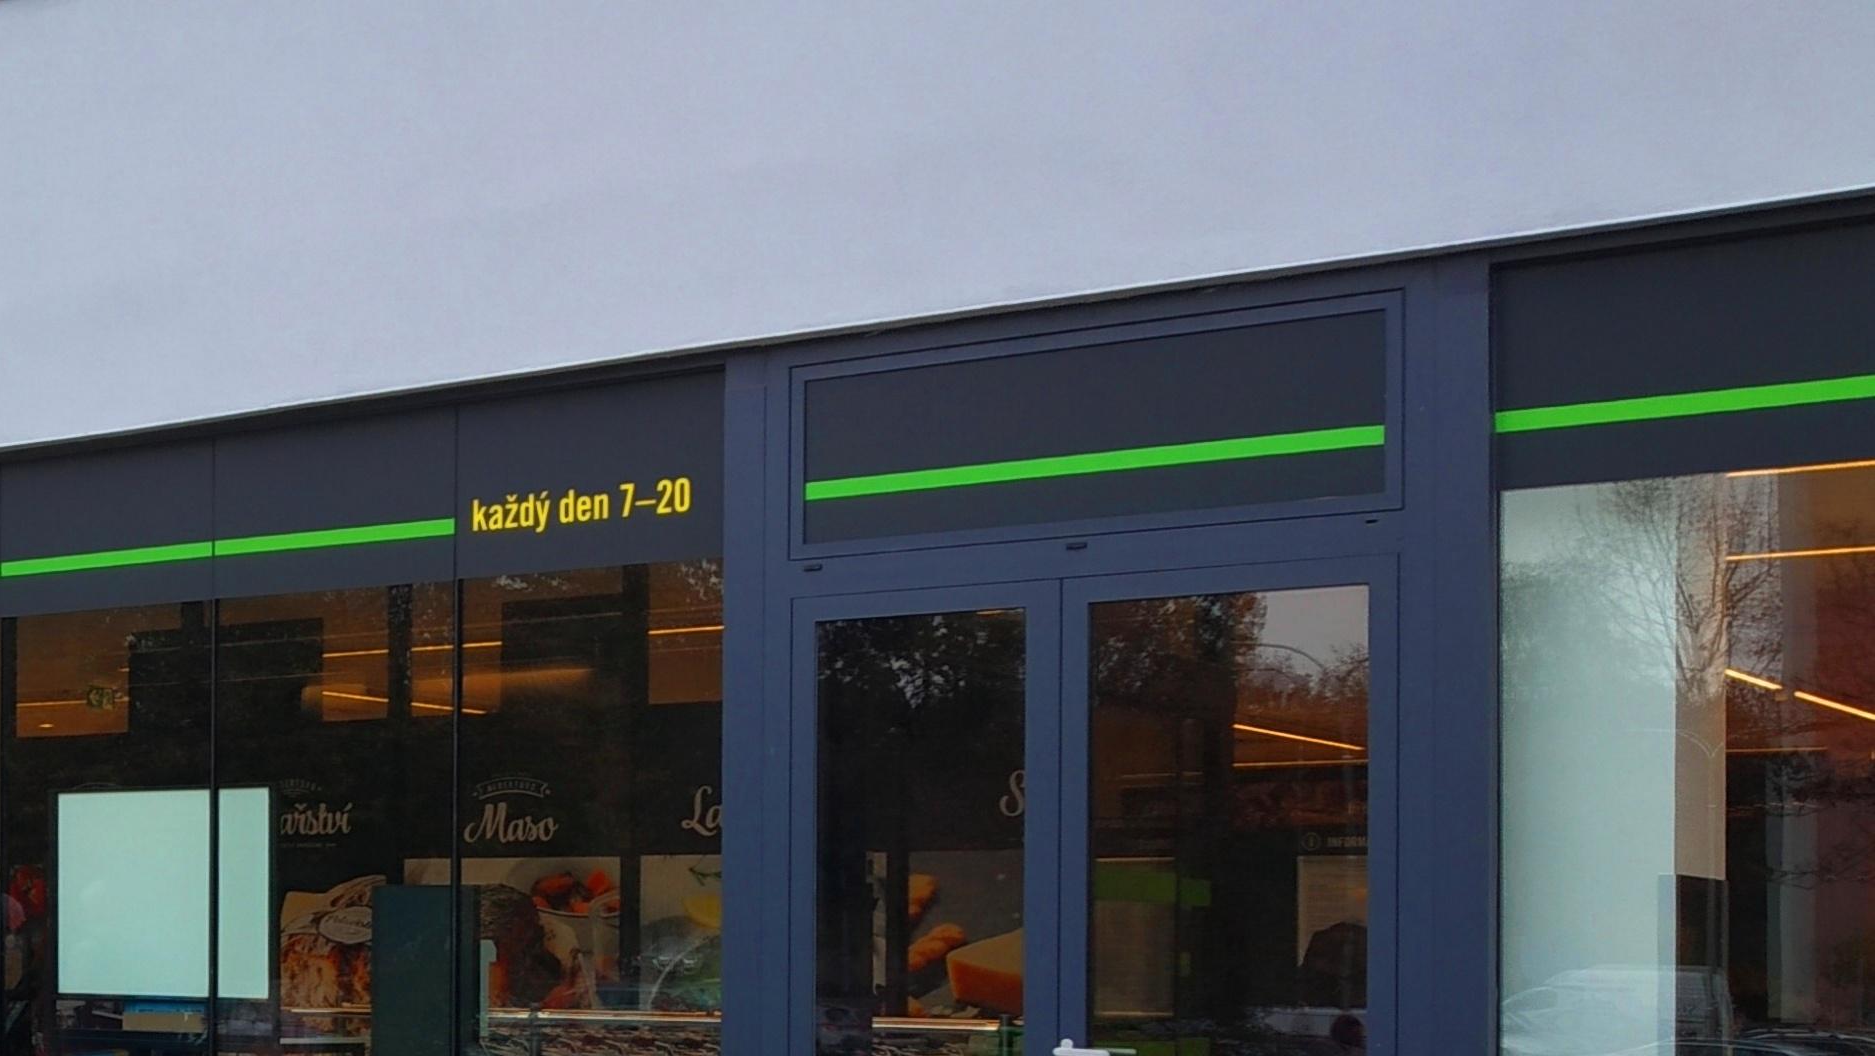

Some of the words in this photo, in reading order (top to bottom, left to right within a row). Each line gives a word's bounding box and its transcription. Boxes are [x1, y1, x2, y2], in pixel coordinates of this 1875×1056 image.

[472, 491, 551, 533] každý
[559, 489, 609, 524] den
[280, 802, 354, 835] ařství
[463, 802, 559, 843] Maso
[1327, 836, 1367, 848] INFORM
